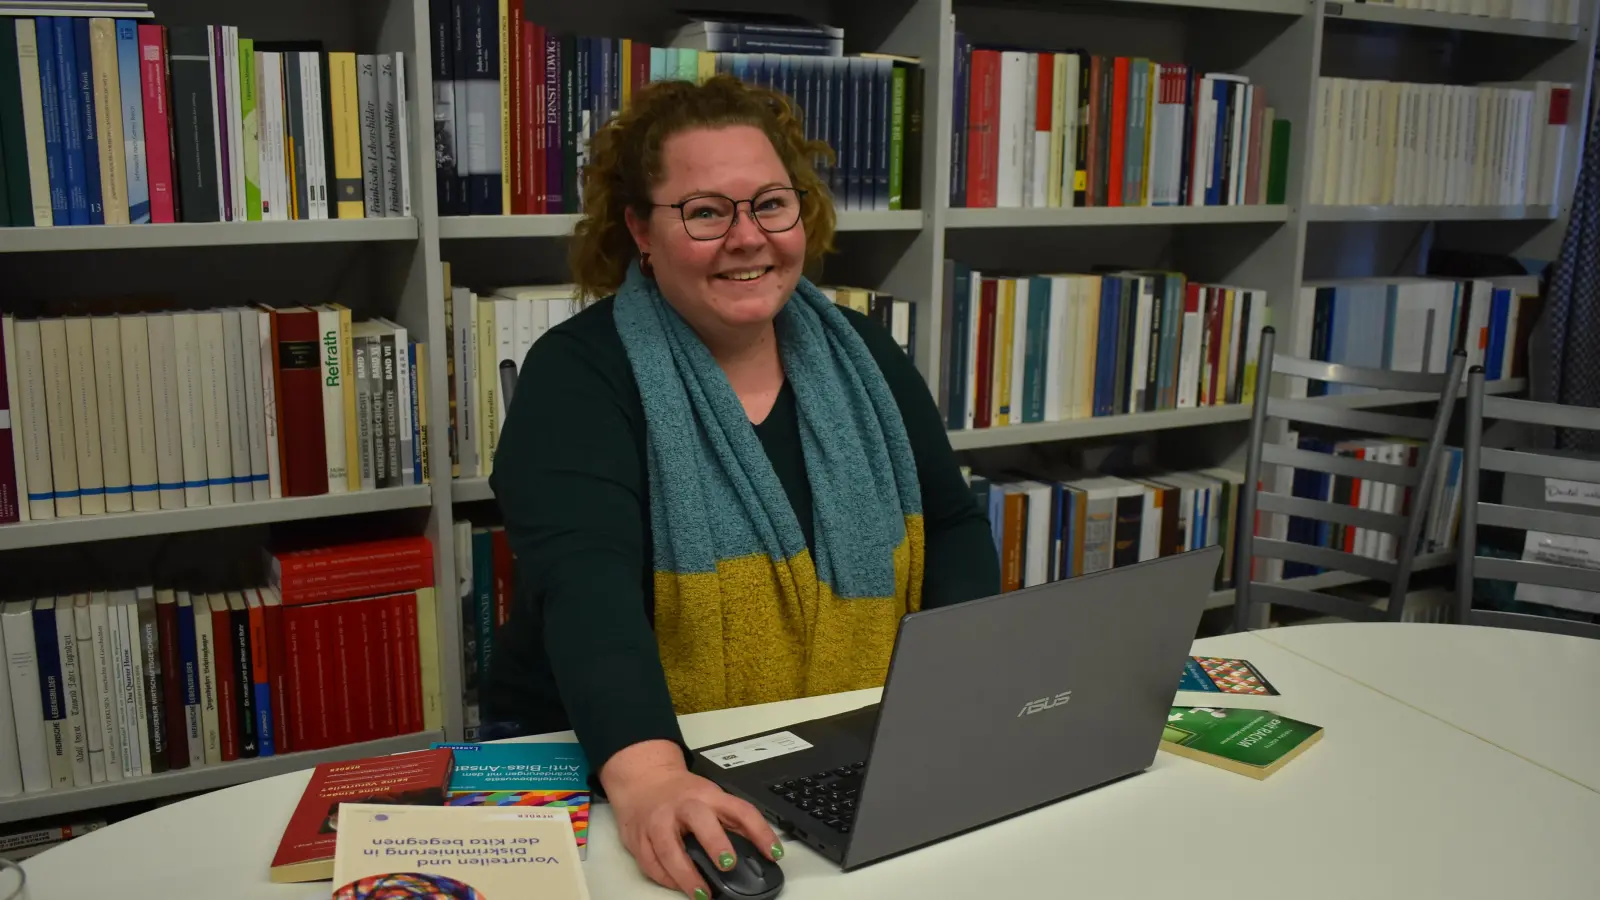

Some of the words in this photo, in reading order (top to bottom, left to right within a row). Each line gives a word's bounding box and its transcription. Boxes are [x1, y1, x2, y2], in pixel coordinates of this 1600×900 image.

[362, 64, 373, 76] 26
[382, 64, 392, 76] 26
[547, 41, 556, 84] LUDWIG
[547, 84, 557, 123] ERNST
[366, 101, 376, 161] Lebensbilder
[385, 101, 396, 161] Lebensbilder
[366, 163, 380, 213] Fränkische
[386, 162, 399, 212] Fränkische
[323, 331, 339, 386] Refrath
[146, 623, 158, 704] WIRTSCHAFTSGESCHICHTE
[48, 676, 59, 718] LEBENSBILDER
[1017, 690, 1072, 718] ASUS
[52, 721, 63, 756] RHEINISCHE
[152, 705, 162, 752] LEVERKUSENER
[1237, 727, 1270, 748] RACISM
[454, 764, 580, 772] Anti-Bias-Ansat
[358, 786, 390, 794] Kleine
[363, 848, 379, 856] in
[372, 837, 463, 846] begegnen
[385, 847, 527, 857] Diskriminierung
[470, 838, 505, 847] Kita
[509, 837, 539, 846] der
[417, 858, 452, 867] und
[457, 856, 559, 866] Vorurteilen
